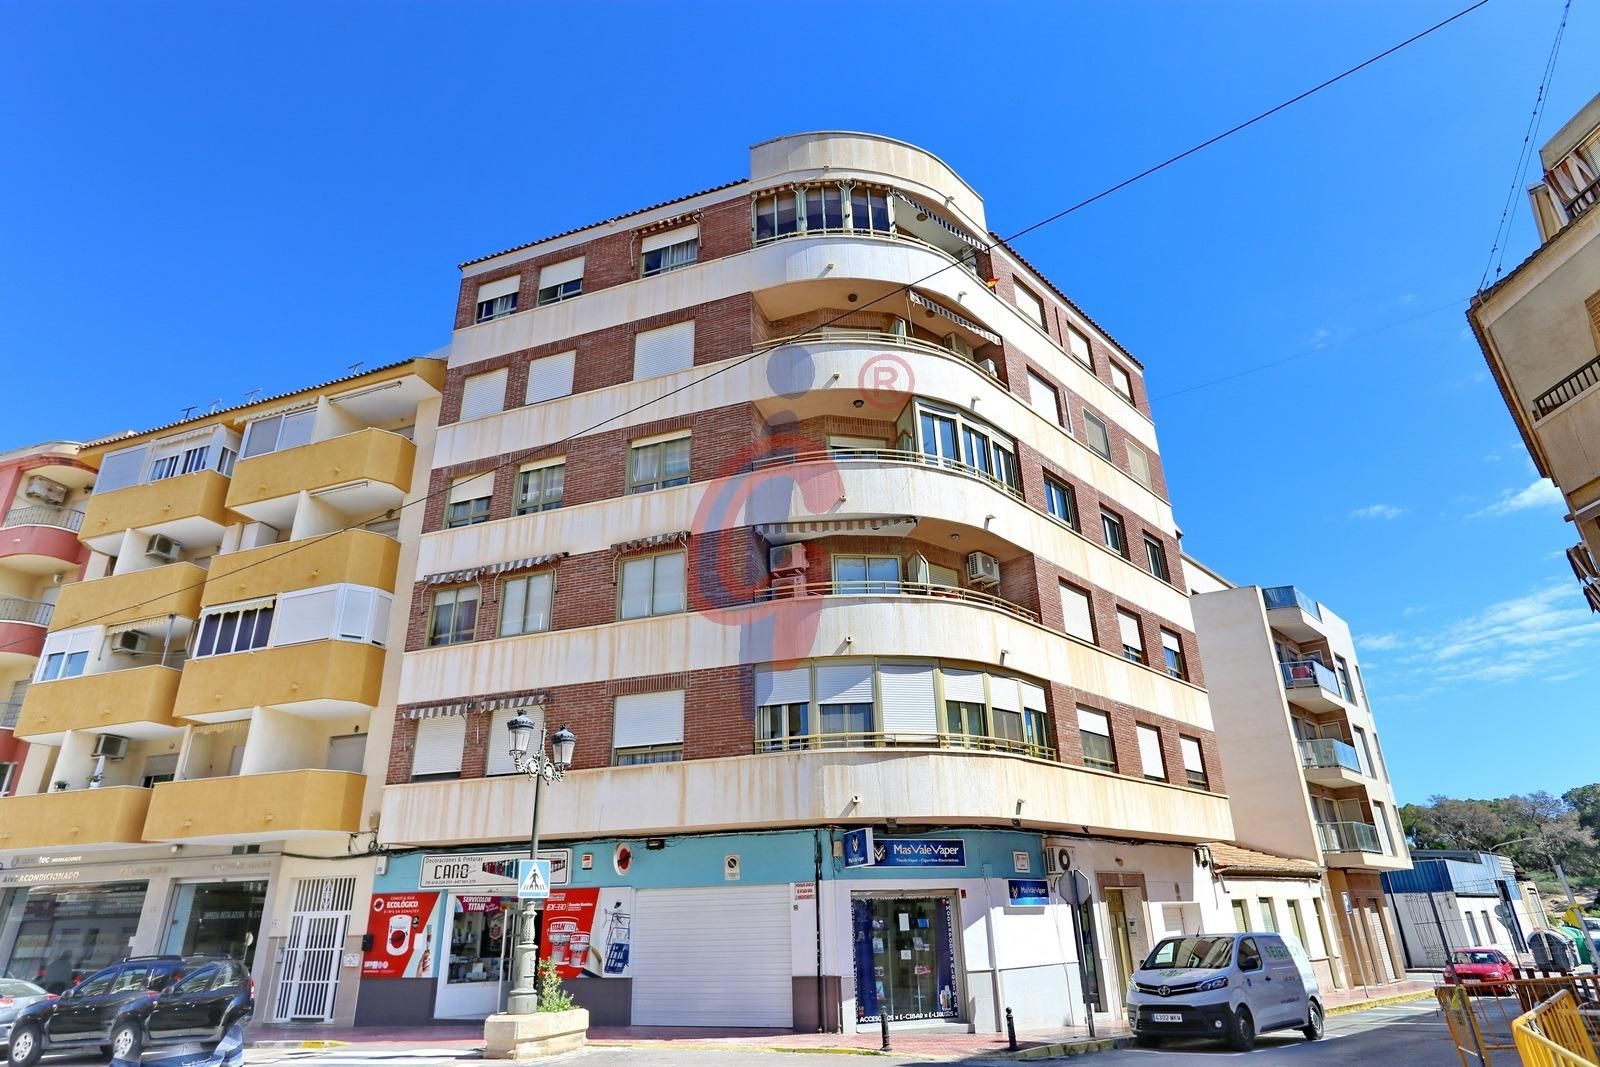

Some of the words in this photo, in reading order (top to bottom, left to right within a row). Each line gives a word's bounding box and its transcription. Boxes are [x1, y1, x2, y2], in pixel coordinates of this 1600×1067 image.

[434, 864, 469, 879] CANO
[19, 872, 80, 881] ACONDICIONADO
[387, 899, 419, 908] ECOLÓGICO
